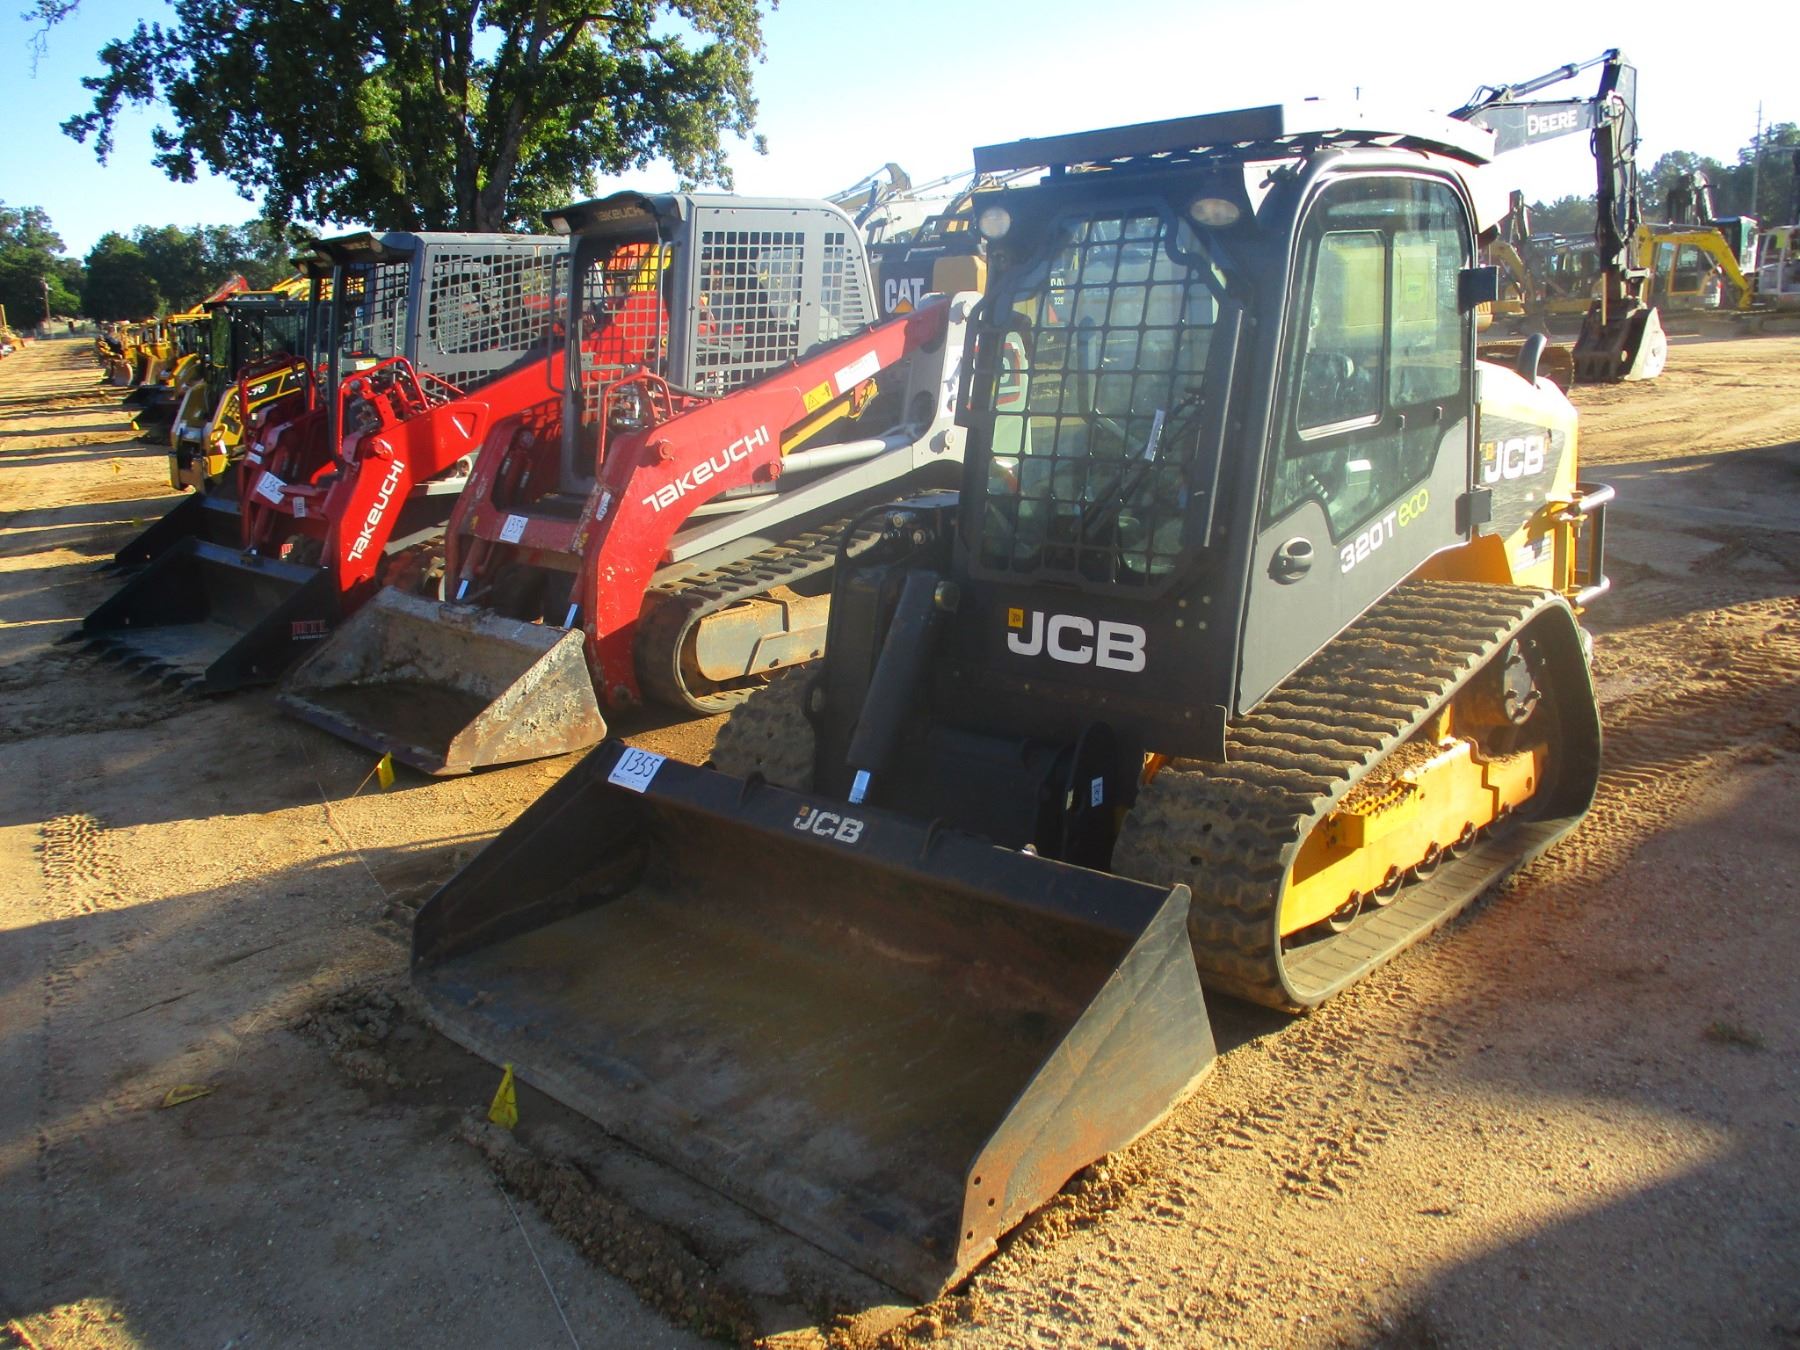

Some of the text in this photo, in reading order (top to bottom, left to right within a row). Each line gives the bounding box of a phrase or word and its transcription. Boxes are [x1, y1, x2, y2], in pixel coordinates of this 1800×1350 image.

[1527, 109, 1578, 136] DEERE
[884, 277, 925, 314] CAT
[1484, 436, 1545, 484] JCB
[1340, 488, 1429, 574] 320T eco
[1007, 608, 1147, 673] JCB
[620, 750, 660, 777] 1355
[793, 808, 864, 844] JCB
